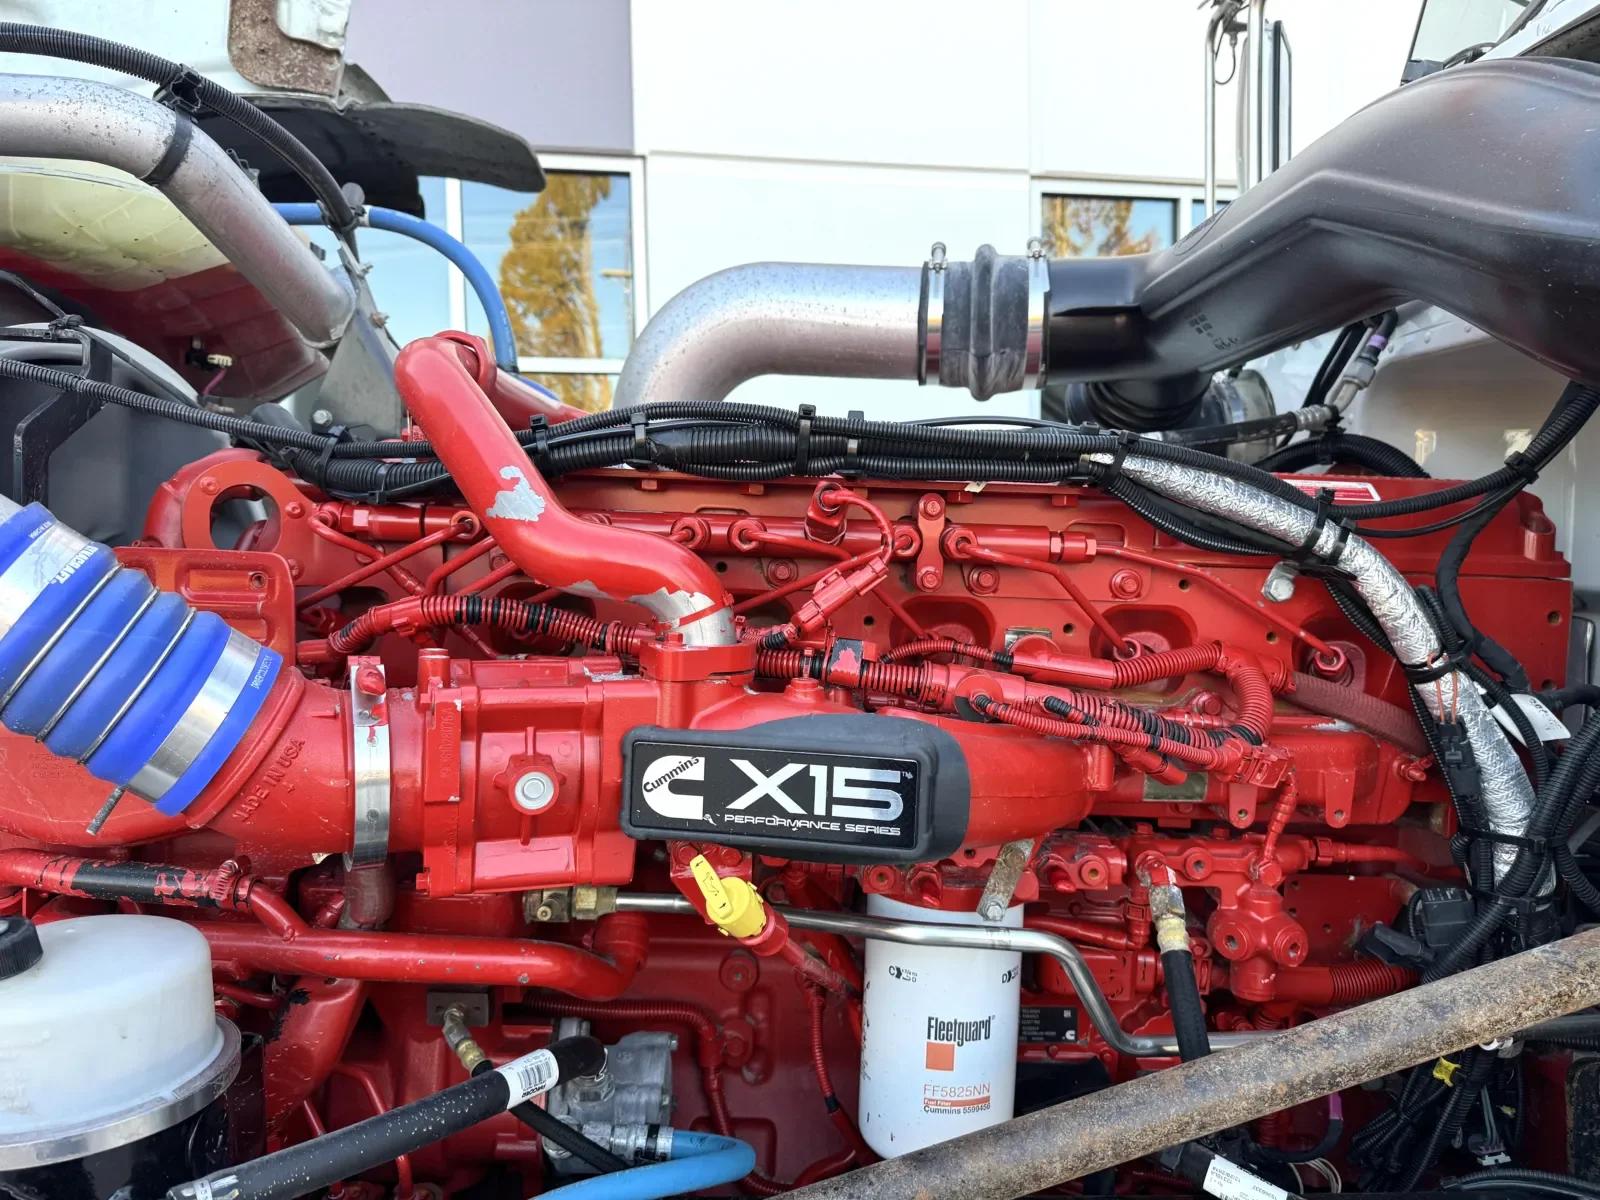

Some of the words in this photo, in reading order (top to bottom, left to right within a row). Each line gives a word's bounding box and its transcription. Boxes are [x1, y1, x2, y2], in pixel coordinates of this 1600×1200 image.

[263, 766, 285, 787] IN
[276, 739, 306, 768] USA
[643, 756, 700, 793] Cummins
[726, 758, 903, 821] X15
[724, 814, 841, 831] PERFORMANCE
[845, 823, 901, 836] SERIES
[927, 1015, 991, 1047] Fleetguard
[923, 1082, 991, 1098] FF5825NN
[923, 1104, 961, 1115] Cummins
